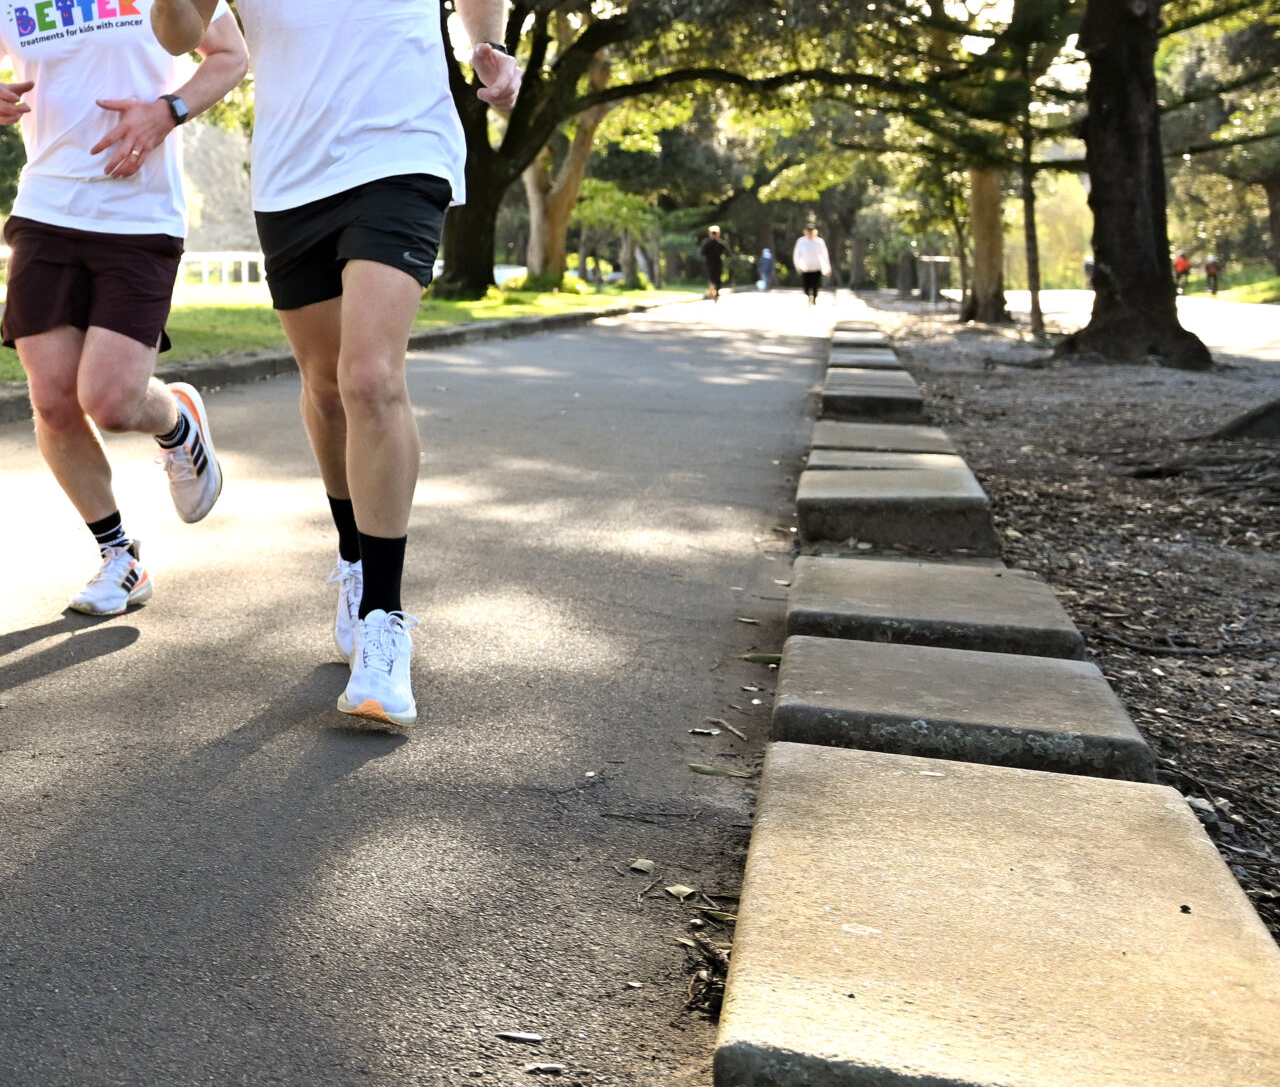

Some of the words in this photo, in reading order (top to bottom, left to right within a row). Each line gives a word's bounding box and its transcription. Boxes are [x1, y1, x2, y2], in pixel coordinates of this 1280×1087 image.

[20, 32, 65, 48] treatments
[65, 28, 78, 37] for
[79, 23, 95, 34] kids
[96, 19, 114, 30] with
[115, 18, 143, 28] cancer
